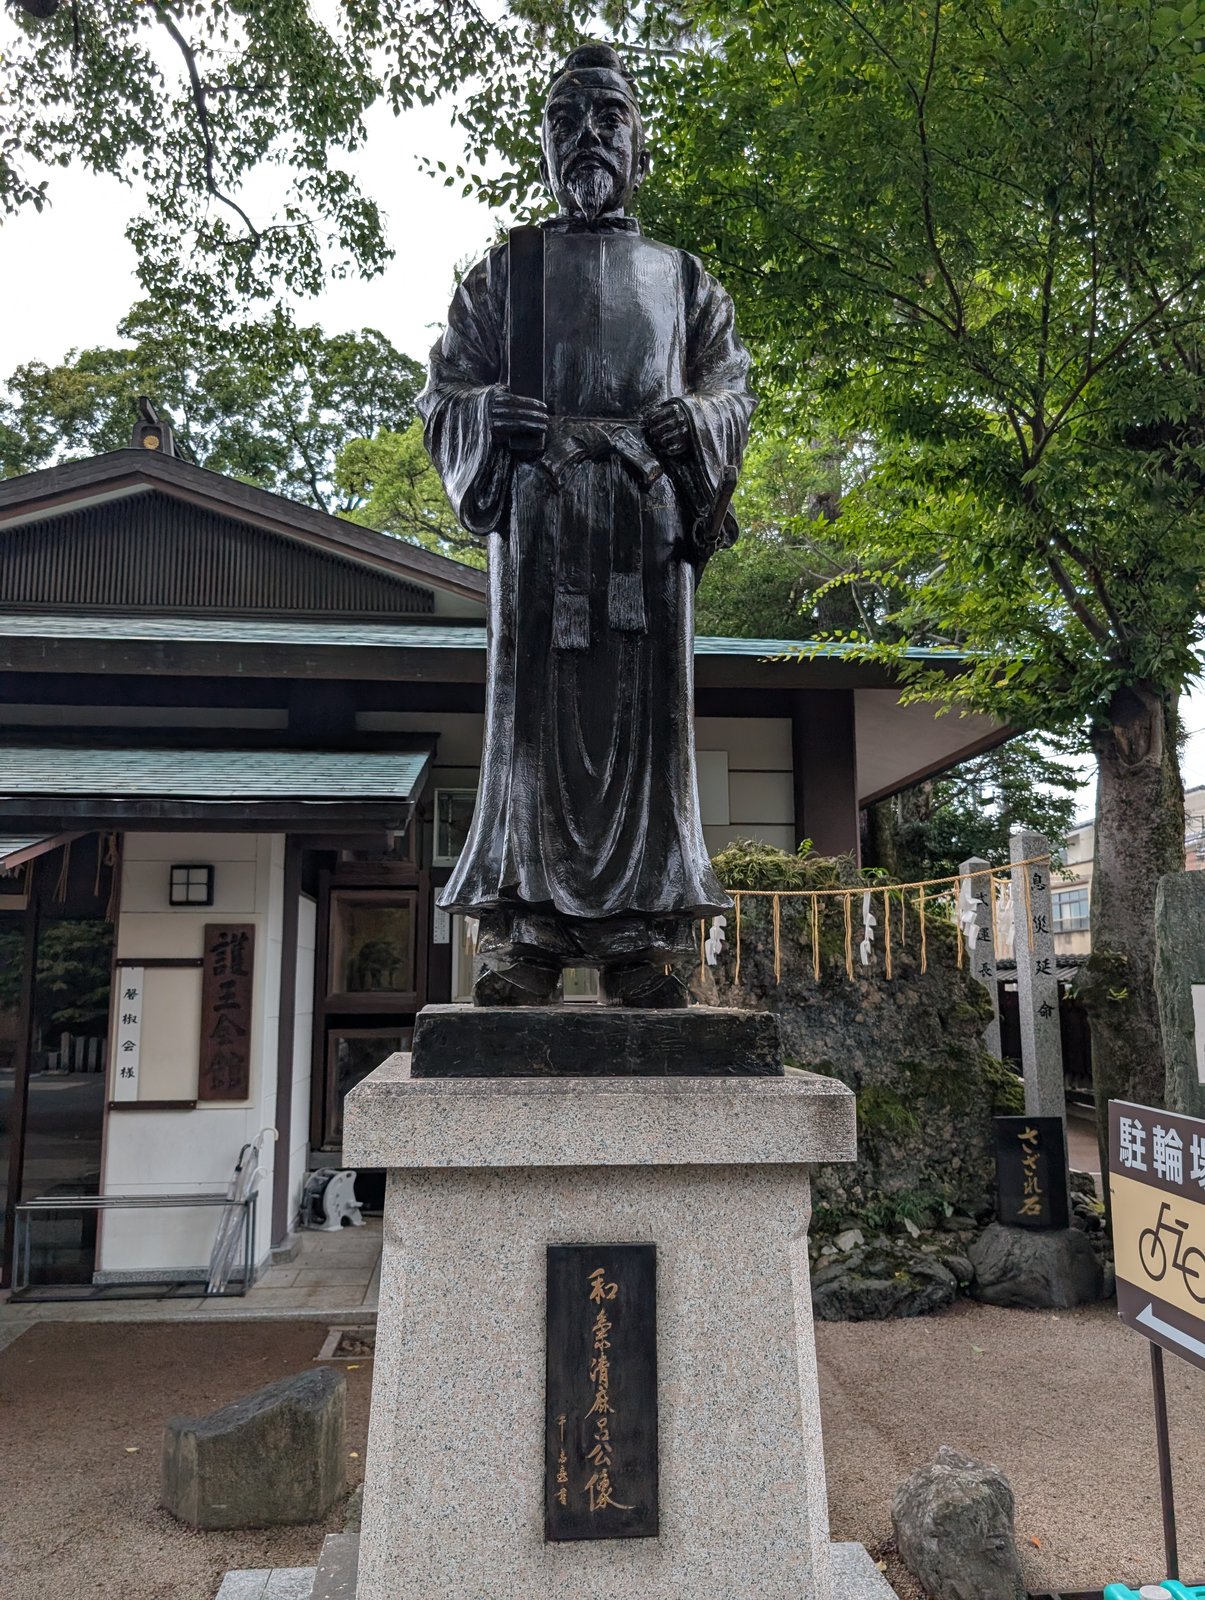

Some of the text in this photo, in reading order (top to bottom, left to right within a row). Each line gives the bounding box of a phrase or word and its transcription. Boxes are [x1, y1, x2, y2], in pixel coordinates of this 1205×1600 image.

[1031, 872, 1056, 1019] 息災延命
[1017, 1126, 1042, 1215] さざれ石
